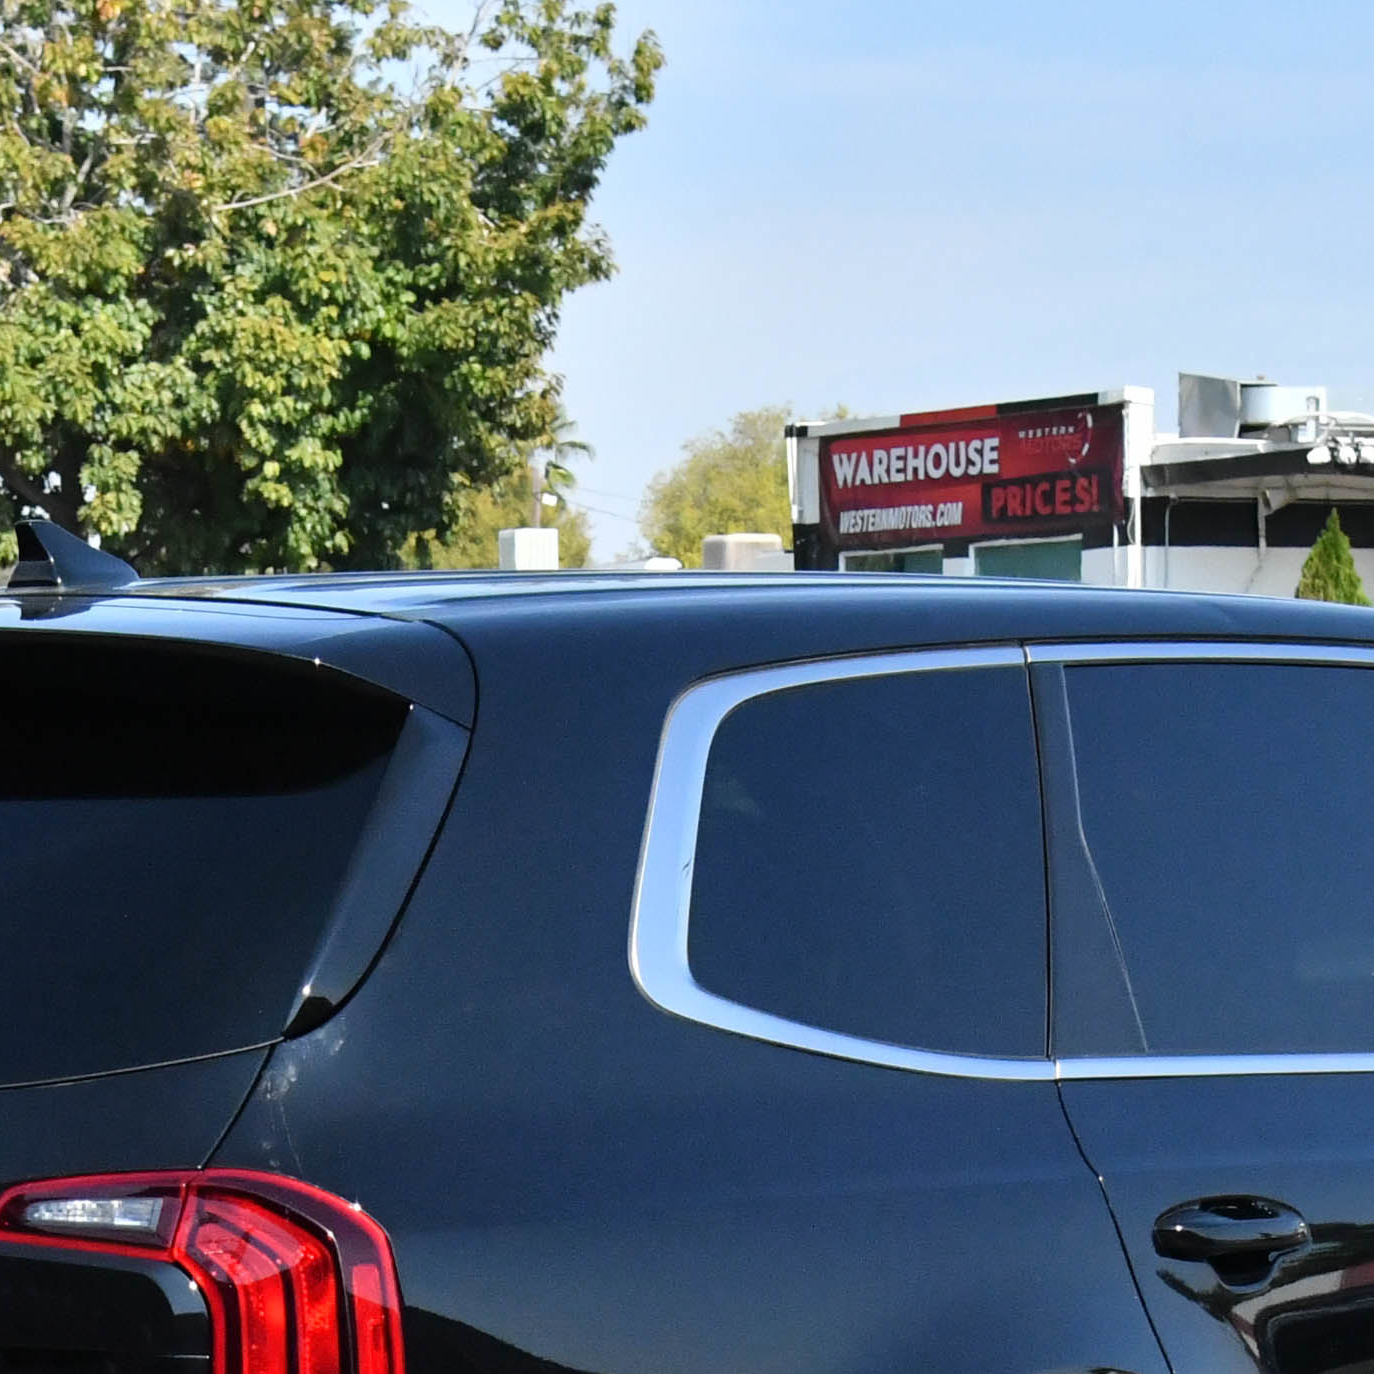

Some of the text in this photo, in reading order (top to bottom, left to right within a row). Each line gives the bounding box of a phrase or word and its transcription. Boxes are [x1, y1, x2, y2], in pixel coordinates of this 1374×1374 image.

[832, 437, 1000, 489] WAREHOUSE
[839, 501, 963, 535] WESTERNMOTORS.COM
[990, 474, 1100, 519] PRICES!
